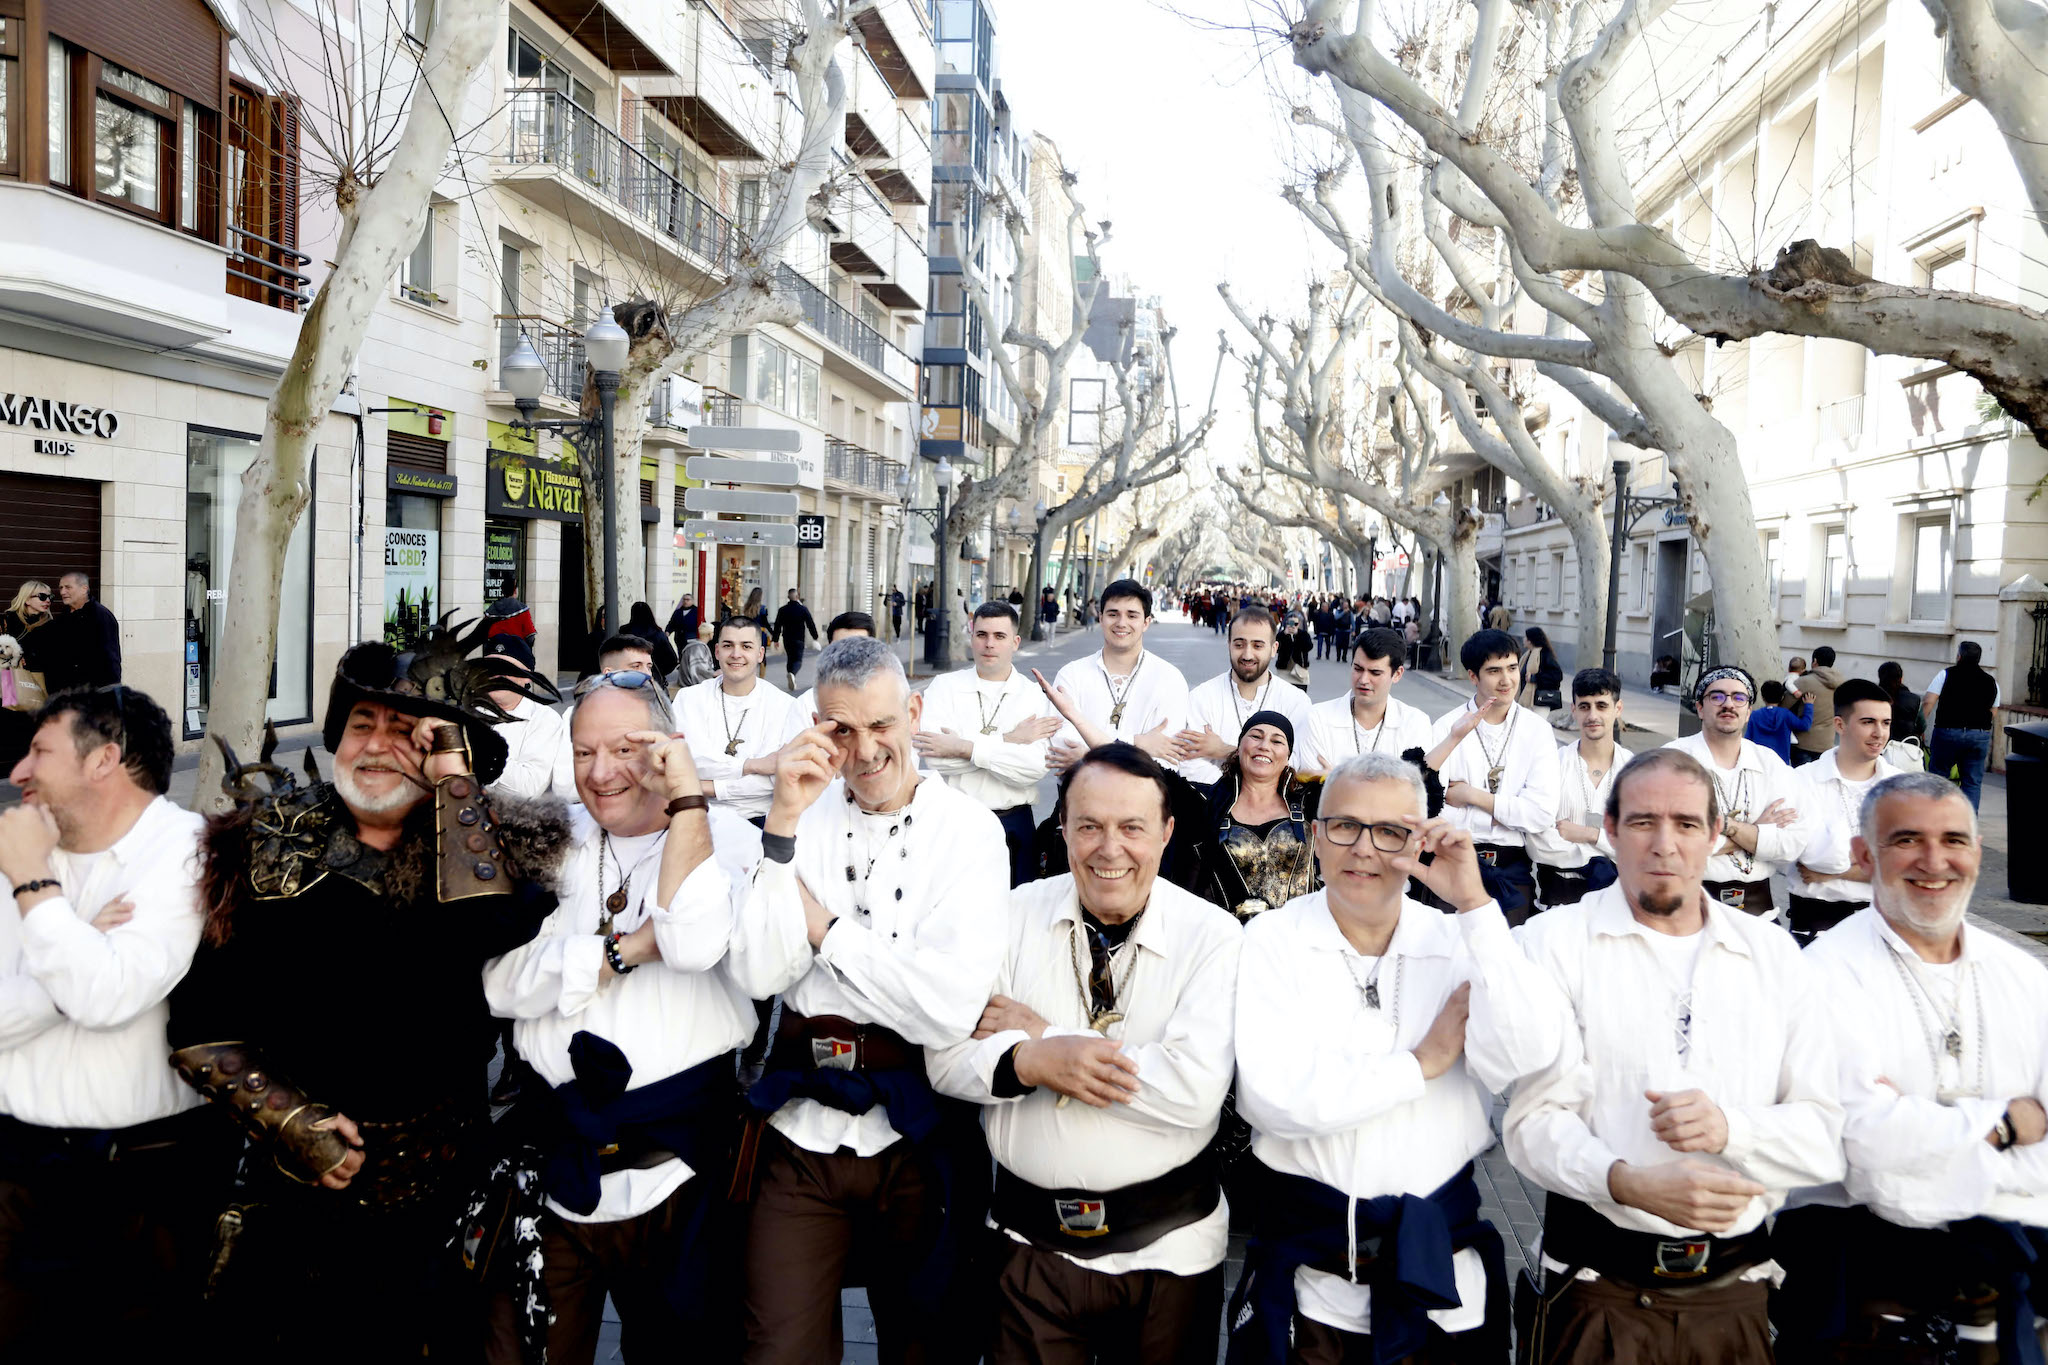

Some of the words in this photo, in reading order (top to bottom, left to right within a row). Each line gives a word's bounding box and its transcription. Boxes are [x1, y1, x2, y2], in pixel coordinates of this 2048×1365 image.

[0, 393, 121, 438] MANGO
[35, 439, 77, 456] KIDS
[528, 467, 583, 513] Navar
[385, 532, 427, 547] ¿CONOCES
[385, 548, 398, 566] EL
[399, 549, 427, 567] CBD?
